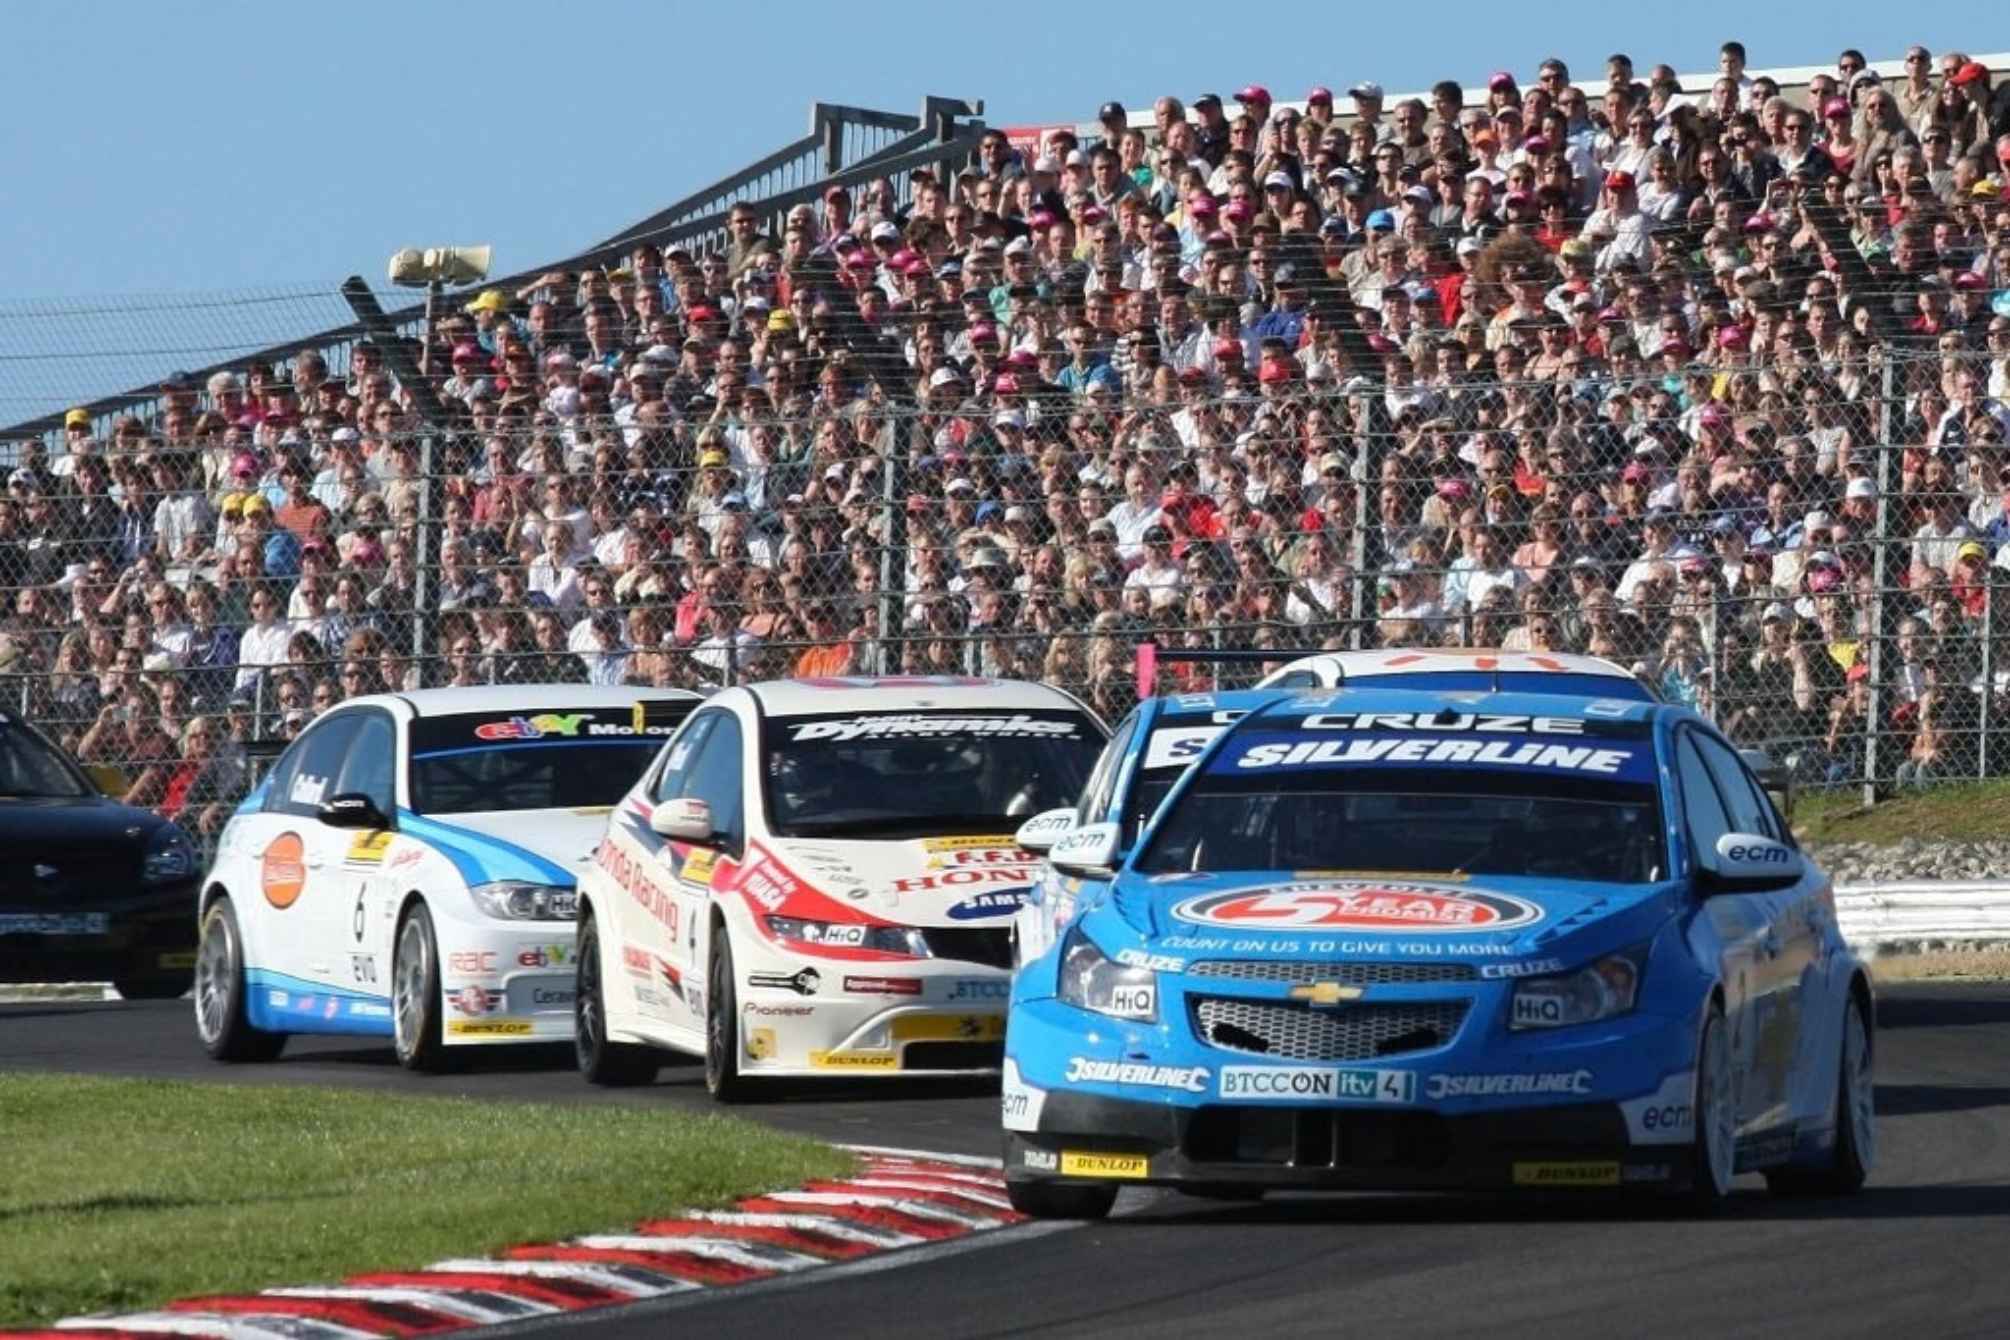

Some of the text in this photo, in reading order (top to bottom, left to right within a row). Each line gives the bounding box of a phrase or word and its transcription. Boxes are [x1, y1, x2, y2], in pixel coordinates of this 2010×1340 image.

[588, 723, 677, 736] Moor
[1301, 713, 1586, 735] CRUZE
[1237, 739, 1633, 774] SILVERLINE
[1025, 815, 1072, 833] ecm
[1057, 832, 1106, 851] ecm
[1728, 844, 1789, 864] ecm
[892, 868, 1029, 893] HON
[353, 881, 367, 943] 6
[826, 927, 861, 944] HiQ
[1160, 935, 1515, 956] COUNT ON US TO GIVE YOU MORE
[1116, 950, 1186, 973] CRUZE
[1480, 958, 1563, 979] CRUZE
[1115, 986, 1152, 1011] HiQ
[744, 1002, 815, 1017] Pioneer
[1515, 997, 1562, 1023] HiQ
[461, 1021, 531, 1034] DUNLOP
[825, 1055, 895, 1066] DUNLOP
[1083, 1060, 1191, 1089] SILVERLINE
[1449, 1074, 1575, 1095] SILVERLINE
[1341, 1073, 1375, 1095] itv
[1383, 1073, 1399, 1098] 4
[1076, 1157, 1144, 1171] DUNLOP
